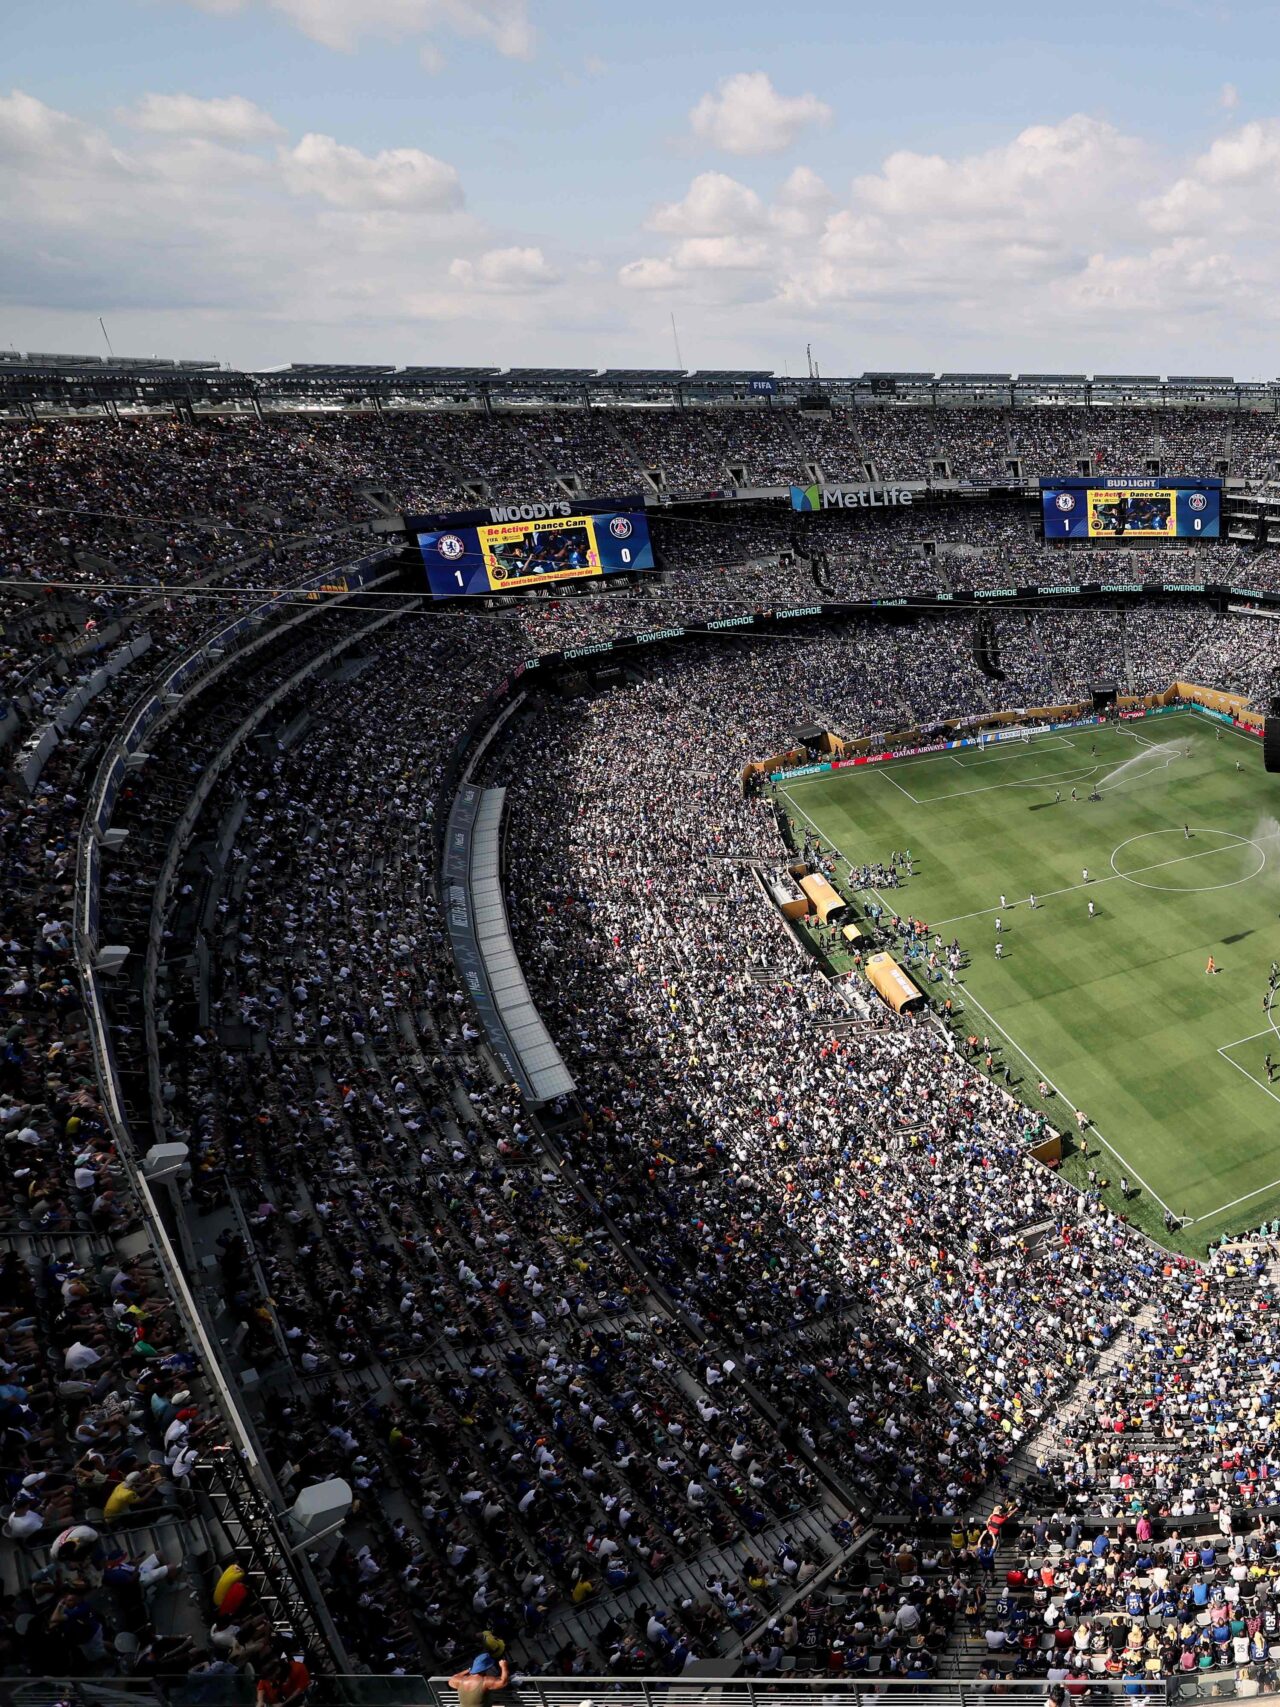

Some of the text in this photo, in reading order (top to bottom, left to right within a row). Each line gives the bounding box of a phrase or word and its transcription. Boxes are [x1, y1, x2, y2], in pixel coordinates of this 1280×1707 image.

[1107, 479, 1157, 487] BUD LIGHT
[823, 486, 913, 509] MetLife
[490, 502, 572, 522] MOODY'S
[501, 526, 529, 534] Active
[534, 522, 564, 530] Dance
[1063, 519, 1070, 531] 1
[1194, 518, 1201, 531] 0
[621, 548, 631, 563] 0
[454, 571, 464, 587] 1
[974, 589, 1017, 598] POWERADE
[1038, 586, 1080, 594] POWERADE
[1230, 587, 1264, 599] POWERADE
[776, 606, 822, 619] POWERADE
[707, 615, 754, 630] POWERADE
[637, 627, 685, 644] POWERADE
[564, 641, 613, 660] POWERADE
[893, 743, 944, 758] QATAR AIRWAYS
[781, 766, 821, 779] Hisense
[465, 970, 481, 991] MetLife
[1265, 1615, 1276, 1627] 25
[1237, 1642, 1246, 1653] 25
